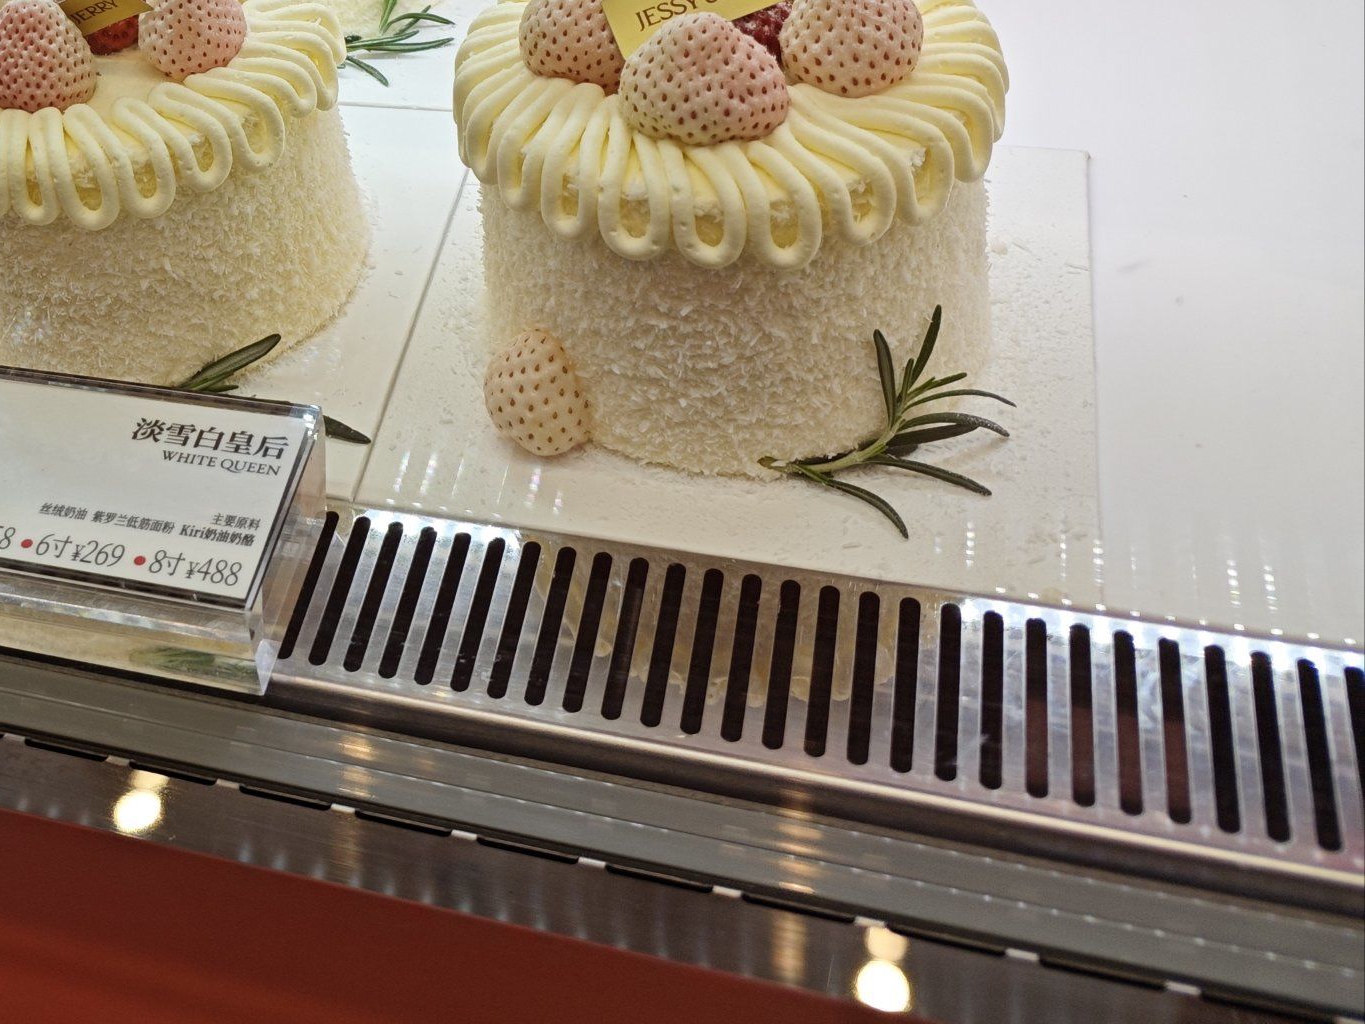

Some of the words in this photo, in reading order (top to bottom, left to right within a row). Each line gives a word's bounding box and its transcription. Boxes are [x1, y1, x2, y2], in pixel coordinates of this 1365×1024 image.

[131, 417, 289, 460] 淡雪白皇后
[162, 450, 218, 467] WHITE
[220, 458, 282, 476] QUEEN
[39, 502, 89, 521] 丝绒奶油
[91, 510, 175, 534] 紫罗兰低筋面粉
[179, 524, 256, 547] Kiri奶油奶酪
[211, 512, 262, 531] 主要原料
